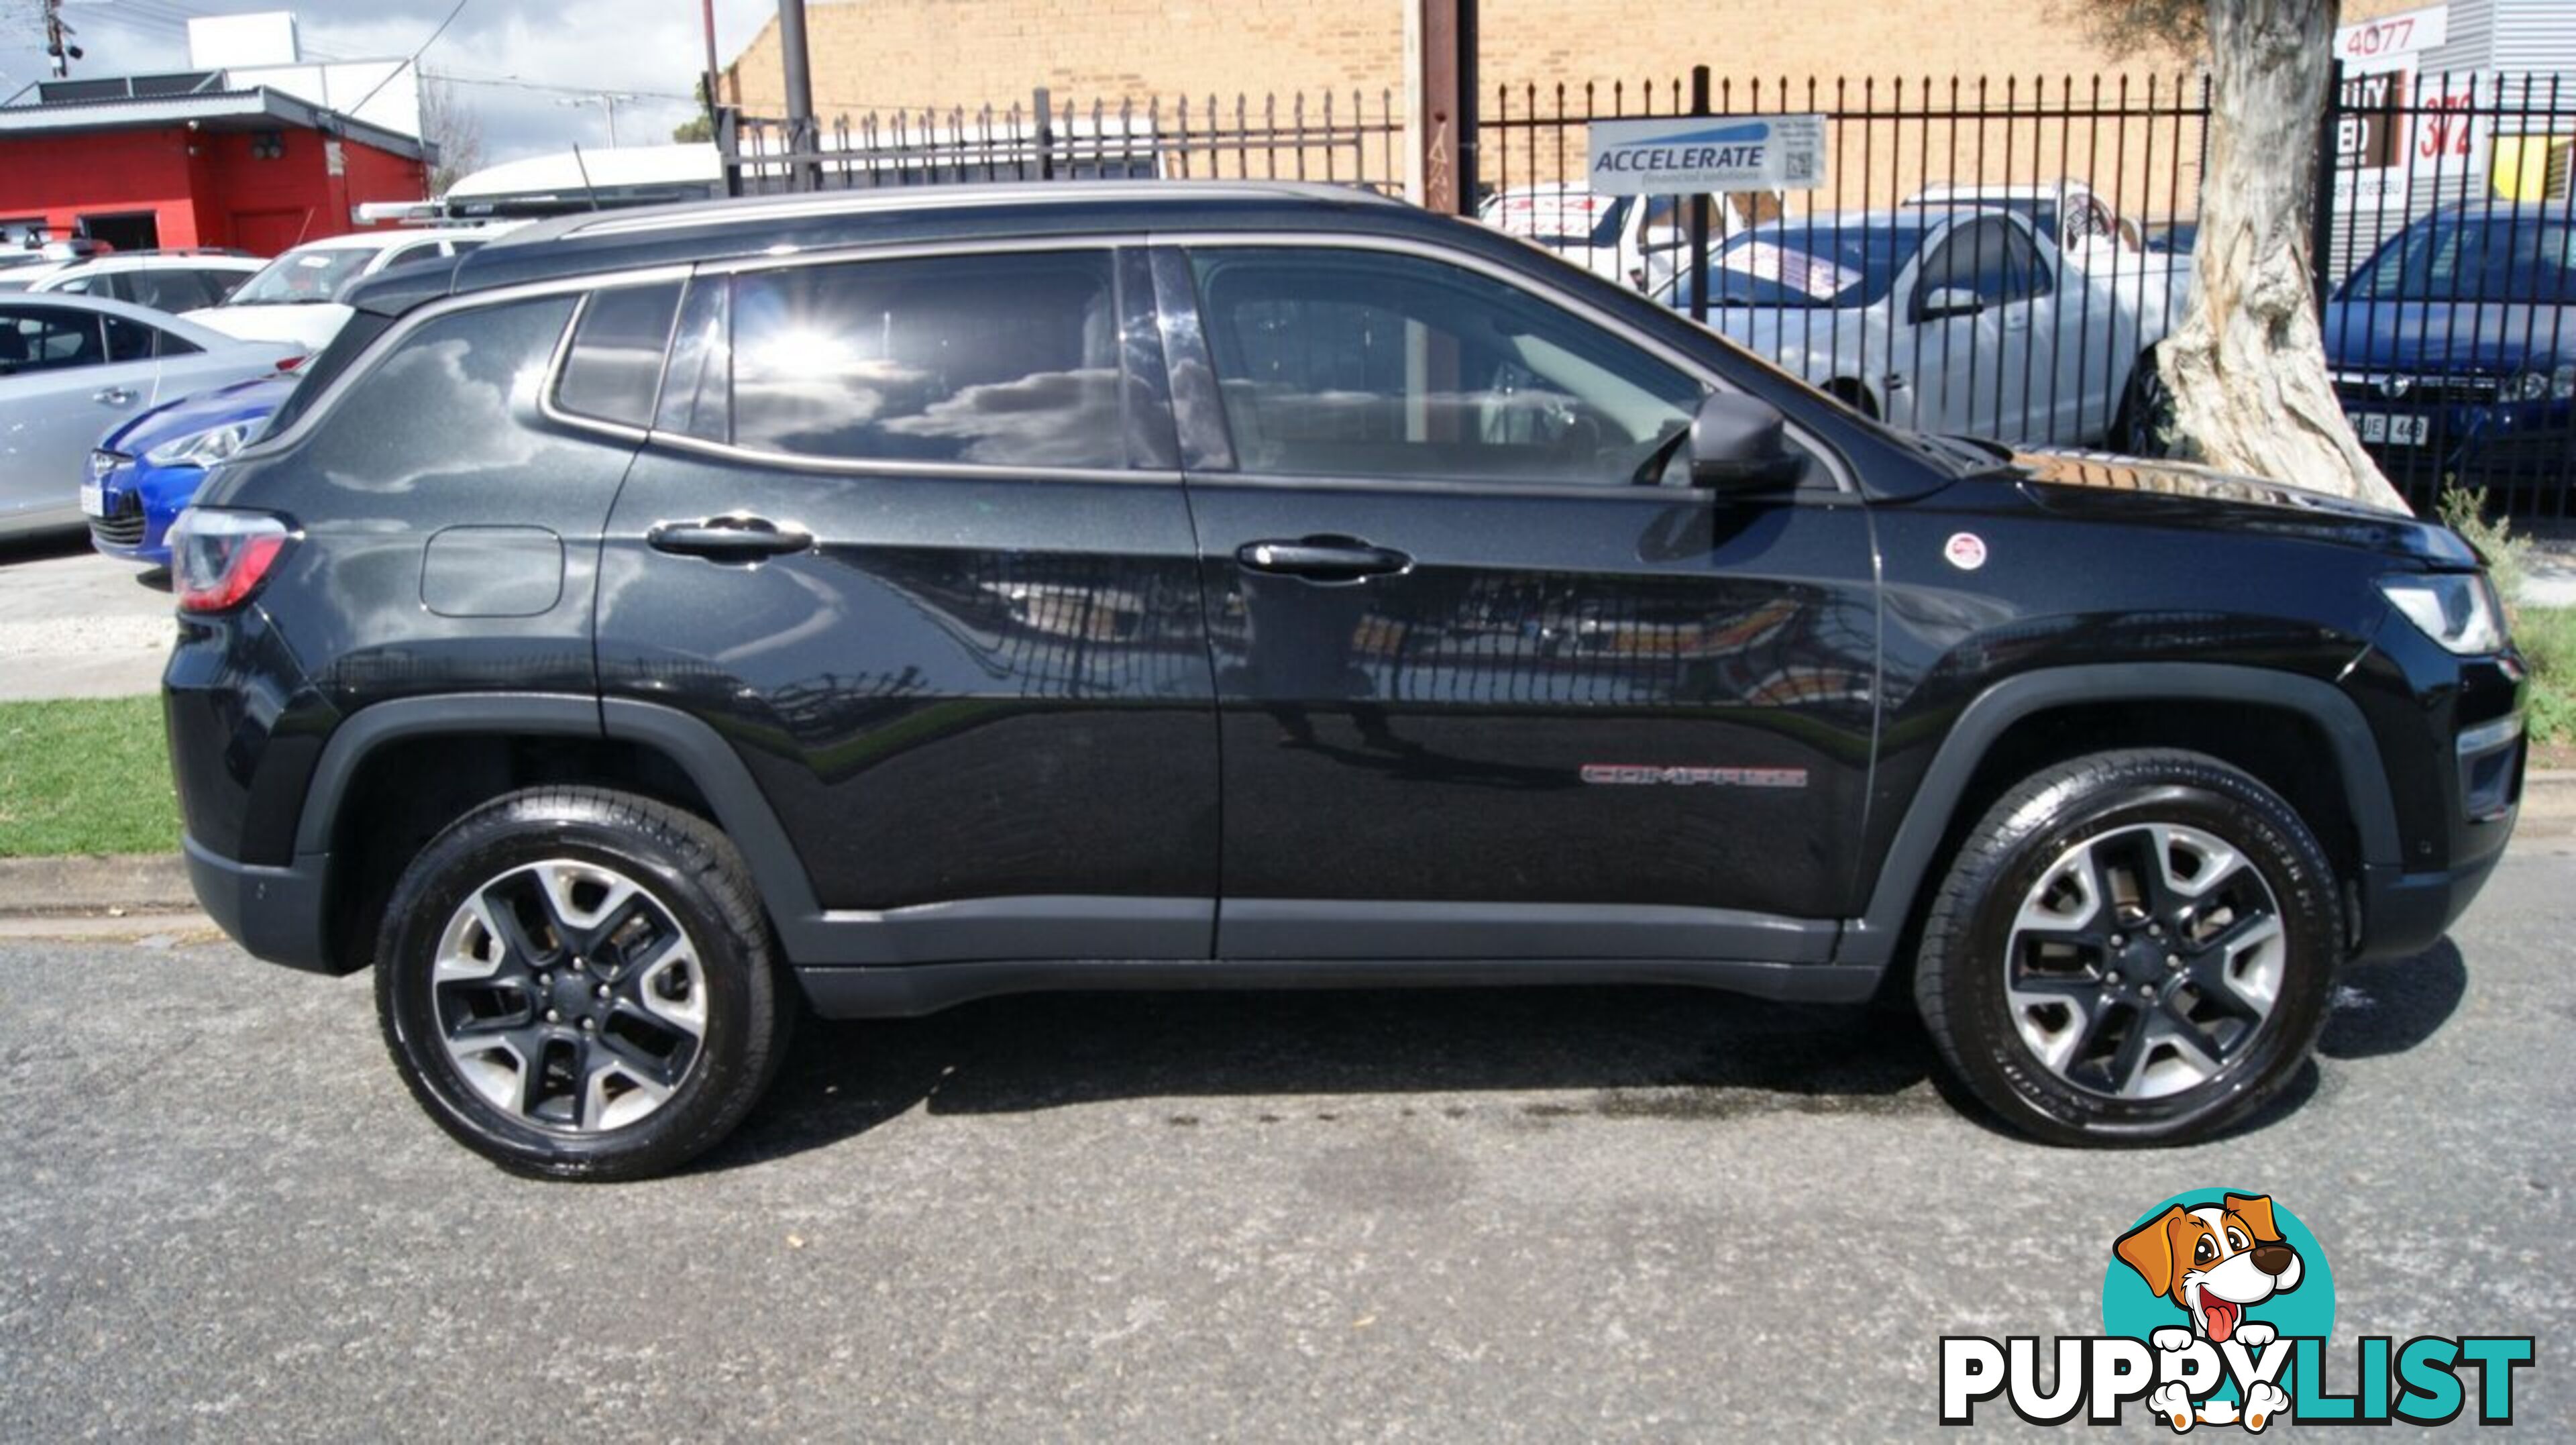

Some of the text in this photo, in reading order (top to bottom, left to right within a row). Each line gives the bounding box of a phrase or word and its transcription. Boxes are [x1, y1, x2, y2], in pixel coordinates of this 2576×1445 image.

[2347, 18, 2415, 55] 4077
[2420, 93, 2472, 158] 372
[1595, 146, 1765, 172] ACCELERATE
